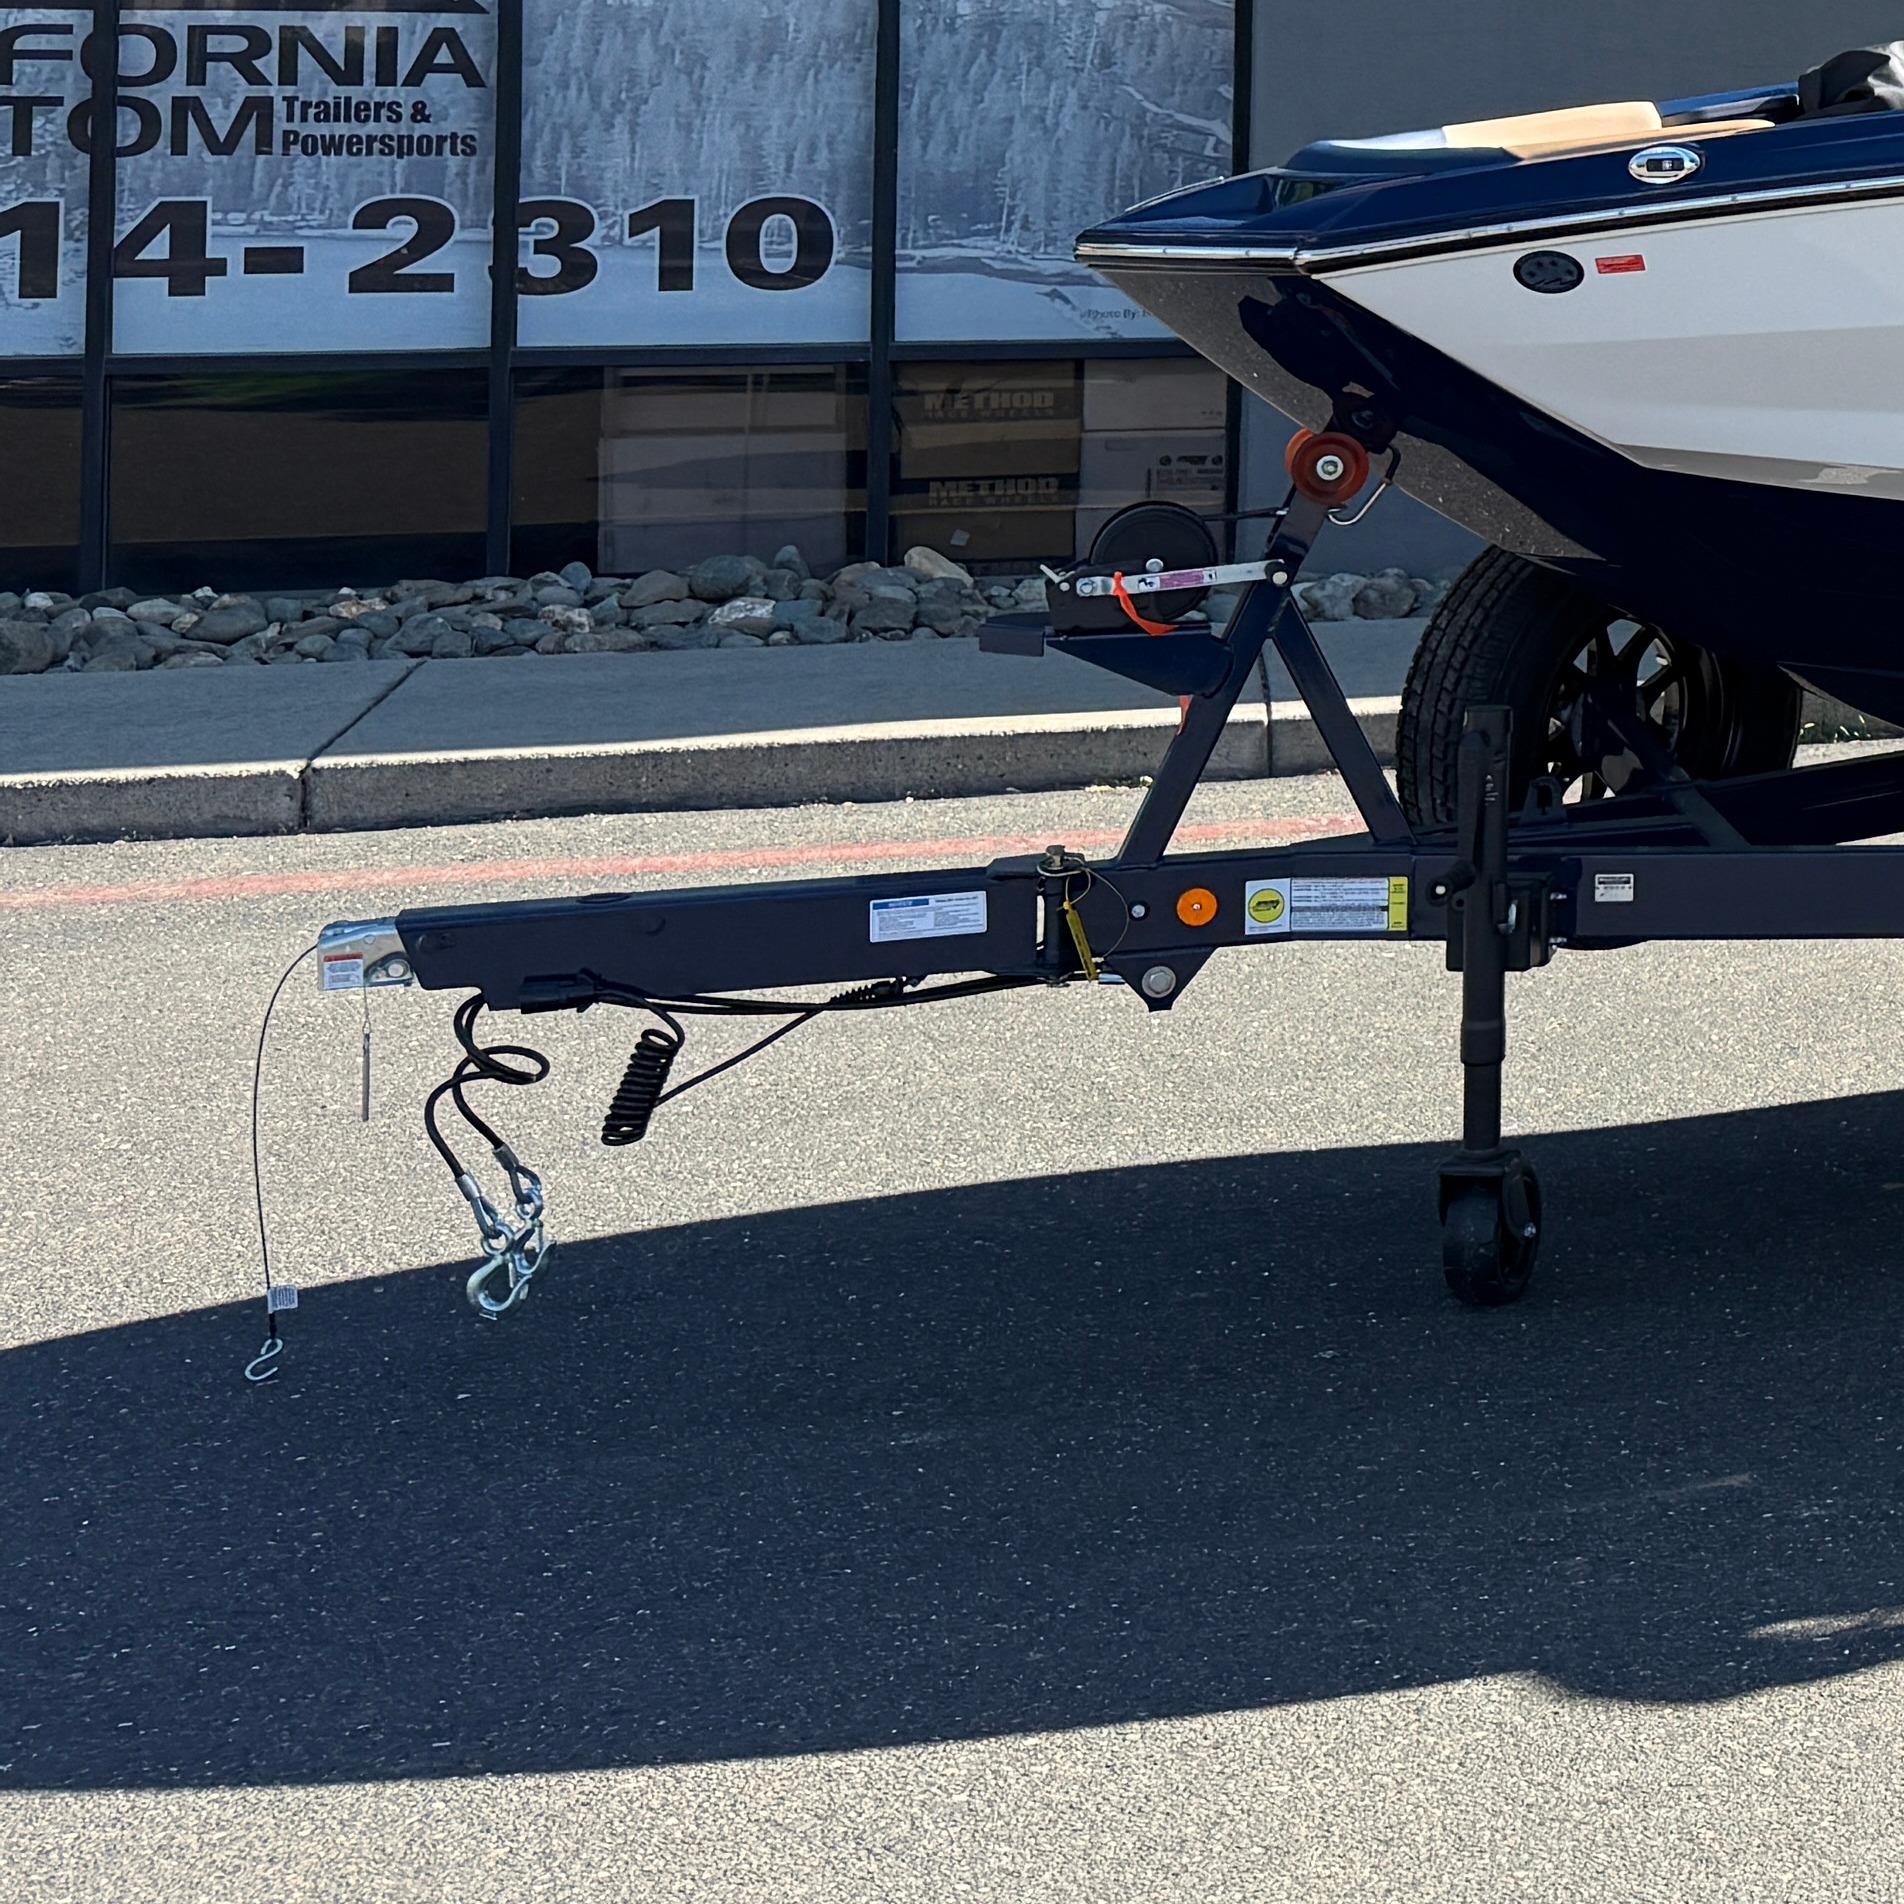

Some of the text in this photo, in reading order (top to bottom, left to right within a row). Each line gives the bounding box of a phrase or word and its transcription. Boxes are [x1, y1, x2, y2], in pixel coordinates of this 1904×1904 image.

[282, 95, 432, 124] Trailers &
[281, 128, 478, 159] Powersports
[928, 477, 1058, 498] METHOD
